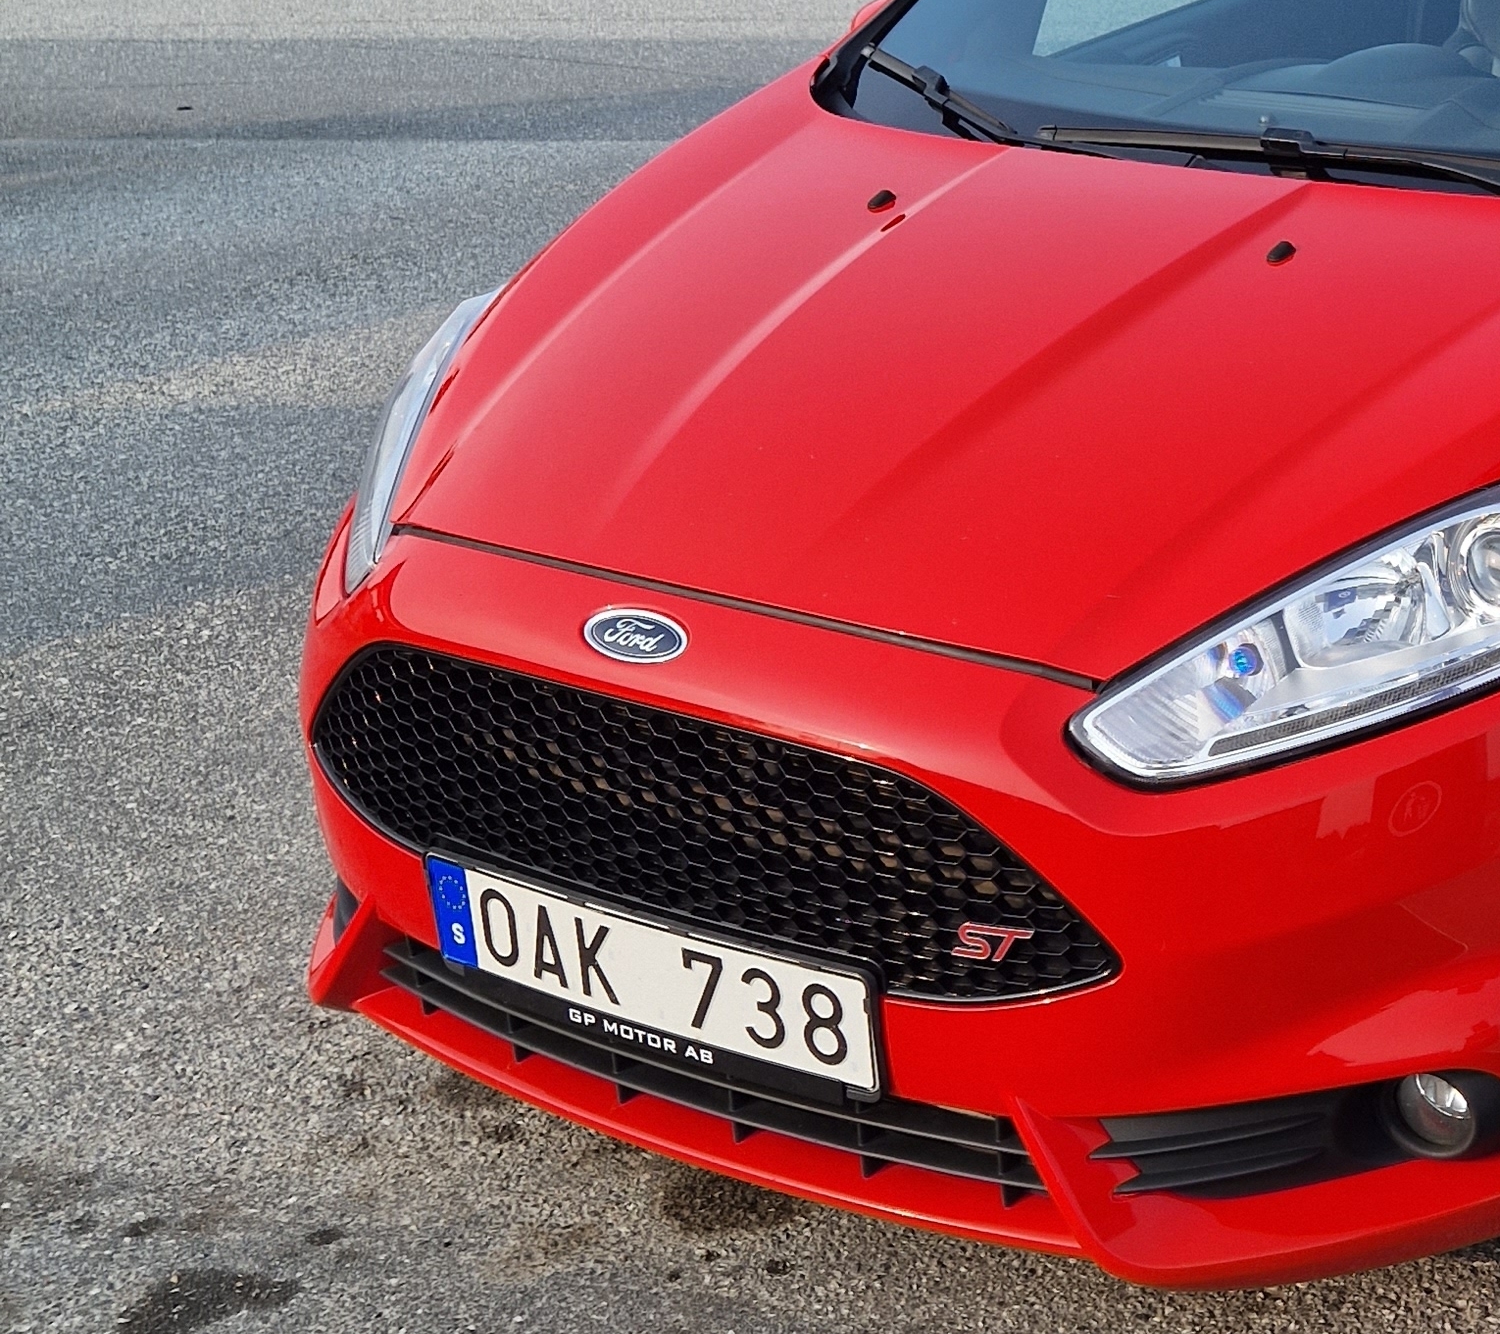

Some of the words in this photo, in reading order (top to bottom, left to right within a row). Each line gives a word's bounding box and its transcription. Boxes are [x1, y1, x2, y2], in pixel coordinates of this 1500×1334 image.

[603, 618, 665, 652] Ford
[951, 922, 1035, 962] ST
[451, 923, 465, 945] S
[479, 888, 620, 1007] OAK
[681, 947, 848, 1066] 738
[569, 1007, 596, 1027] GP
[603, 1019, 677, 1053] MOTOR
[684, 1045, 714, 1065] AB
